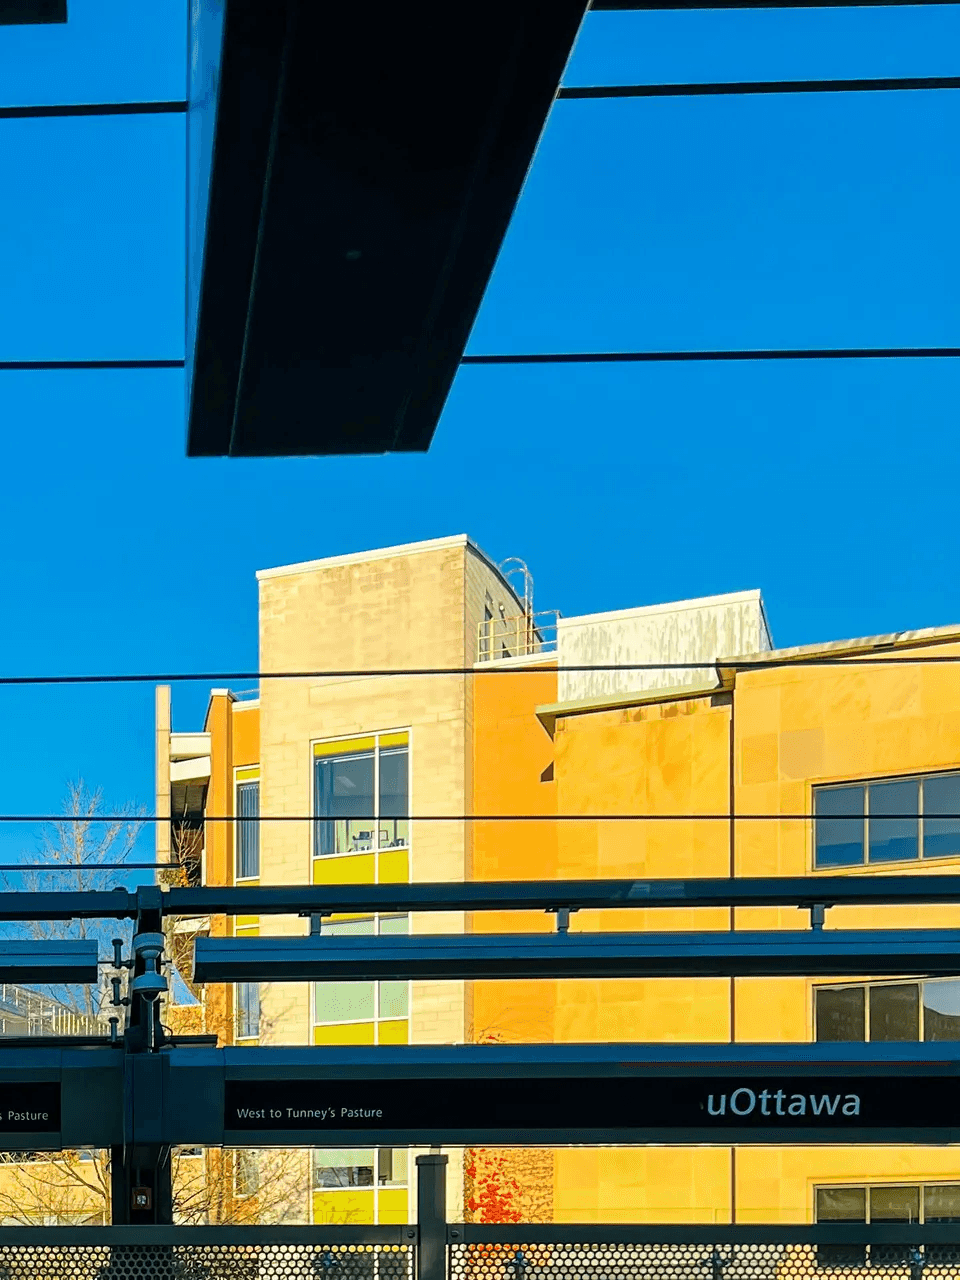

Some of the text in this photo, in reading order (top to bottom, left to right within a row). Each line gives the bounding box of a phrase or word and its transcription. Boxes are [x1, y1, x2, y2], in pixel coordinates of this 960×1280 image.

[706, 1087, 861, 1116] uOttawa
[8, 1110, 49, 1121] Pasture
[236, 1107, 383, 1121] West to Tunney's Pasture
